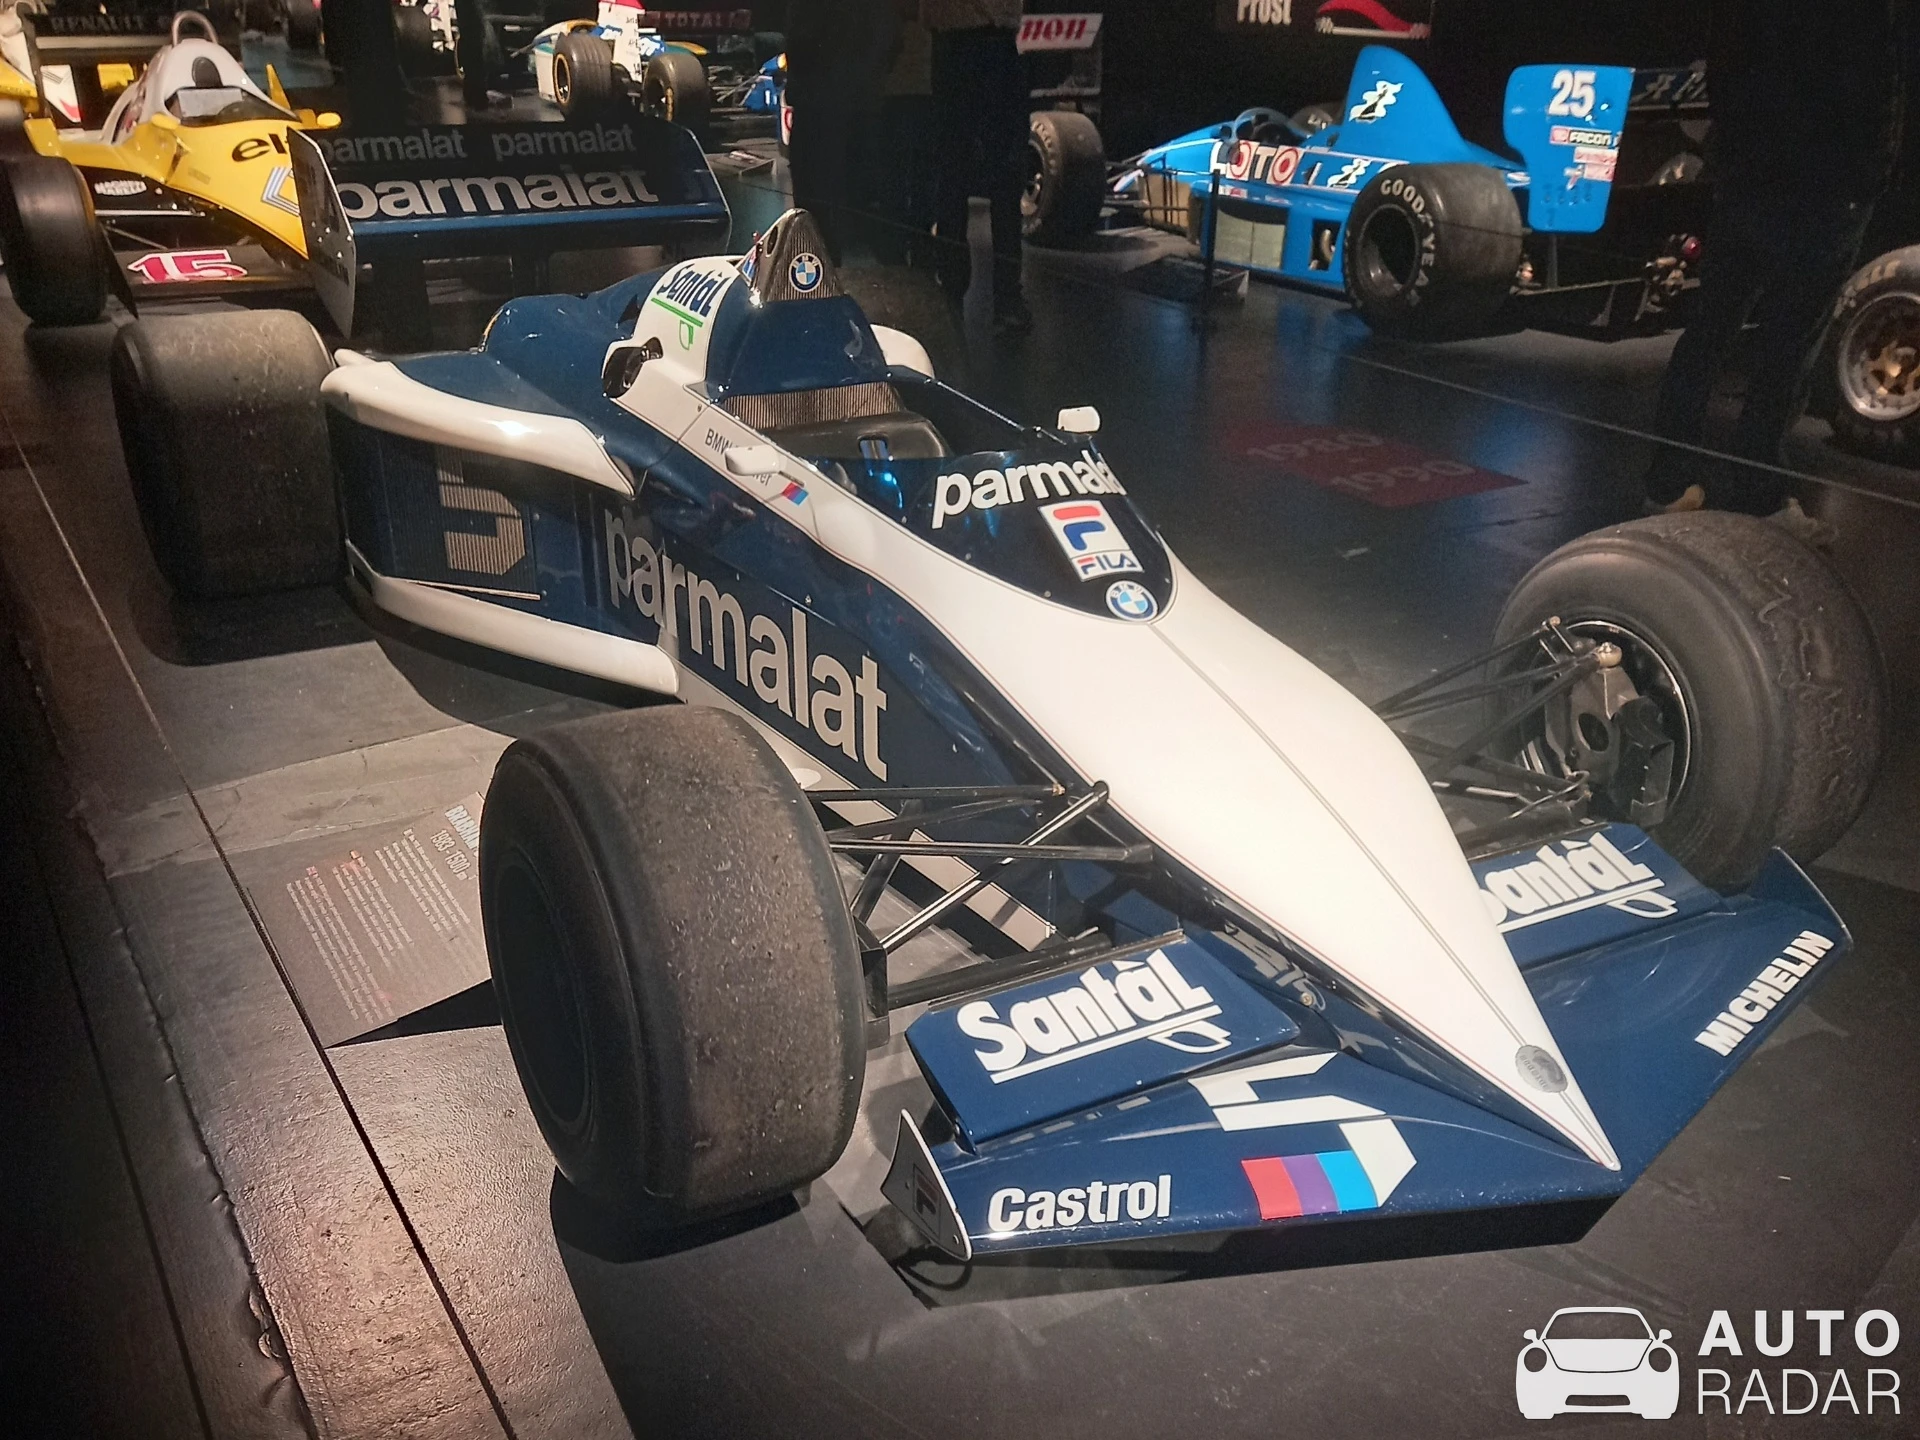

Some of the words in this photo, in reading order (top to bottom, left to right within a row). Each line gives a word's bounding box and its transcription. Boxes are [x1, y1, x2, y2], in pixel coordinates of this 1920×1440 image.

[1549, 70, 1596, 117] 25
[492, 123, 637, 161] parmalat
[127, 250, 248, 285] 15
[1077, 555, 1137, 576] FILA
[605, 507, 888, 783] parmalat
[1694, 929, 1835, 1058] MICHELIN
[987, 1174, 1172, 1233] Castrol
